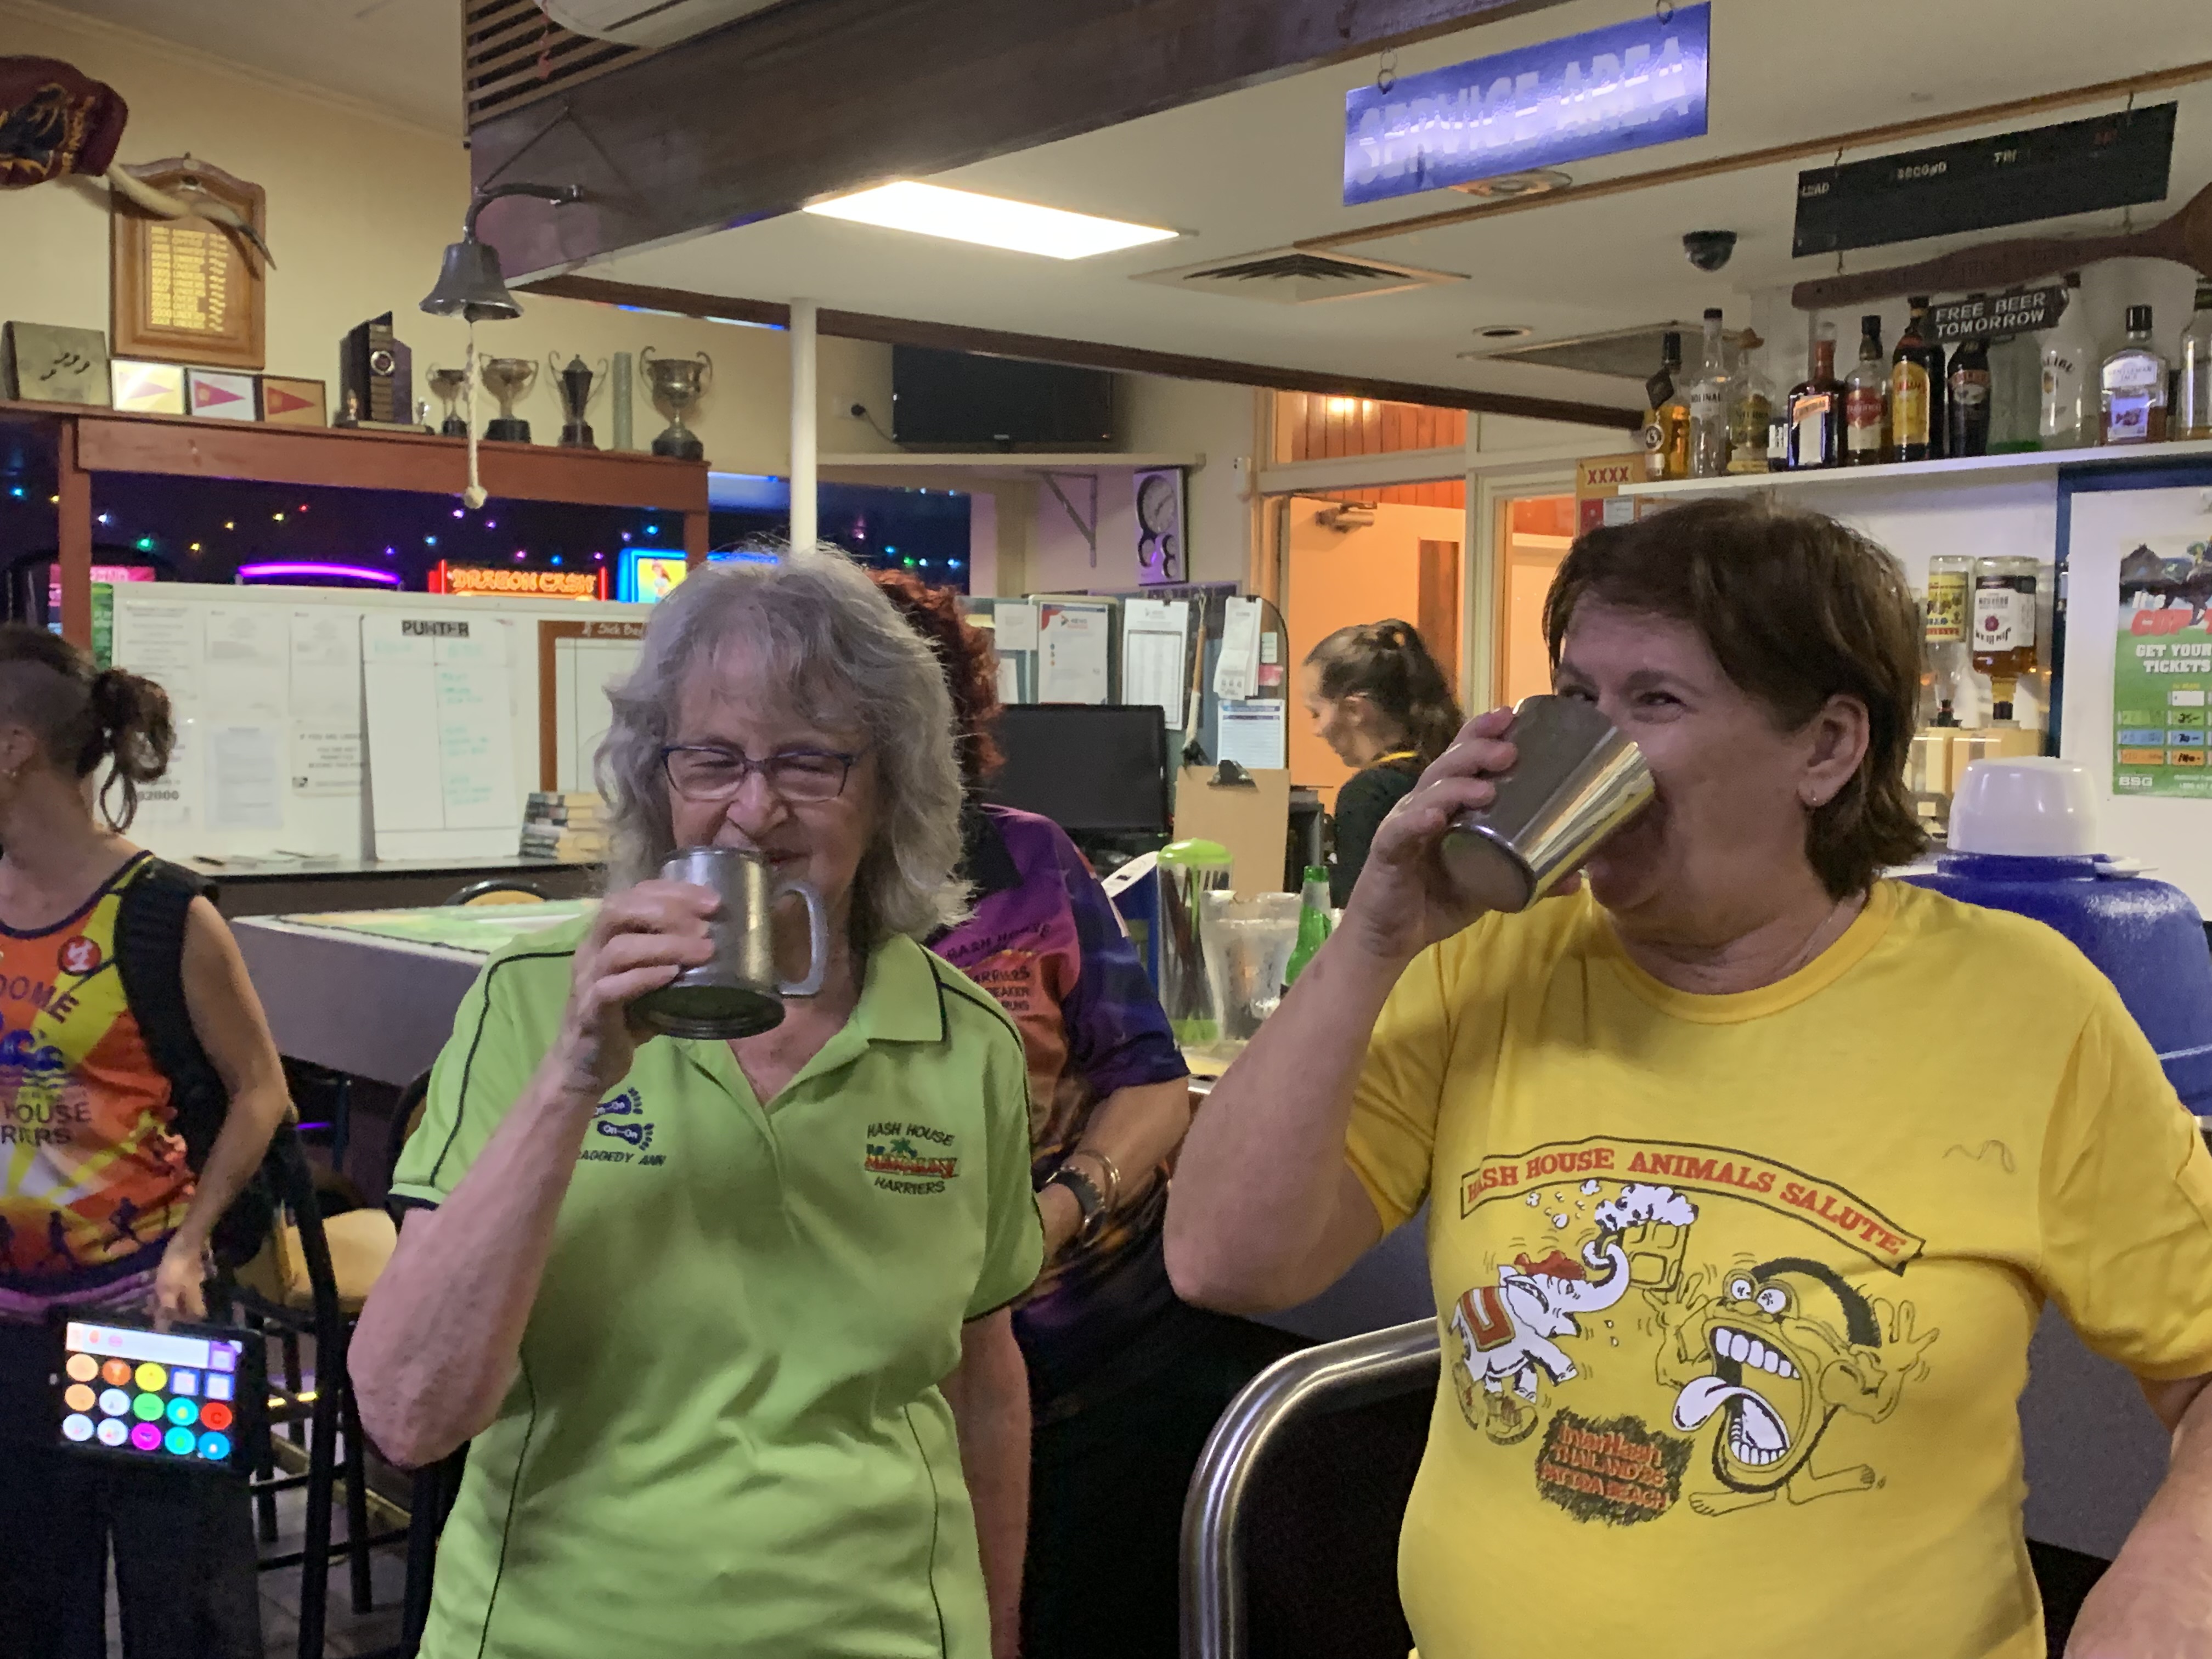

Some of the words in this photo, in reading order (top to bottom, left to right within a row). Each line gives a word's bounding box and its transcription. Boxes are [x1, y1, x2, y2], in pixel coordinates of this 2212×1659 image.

[1935, 302, 1984, 323] FREE
[1995, 291, 2046, 314] BEER
[1936, 308, 2045, 339] TOMORROW
[1587, 466, 1629, 485] XXXX
[452, 569, 538, 591] DRAGON
[538, 573, 597, 594] CASH
[2136, 644, 2166, 657] GET
[2171, 643, 2212, 657] YOUR
[2143, 659, 2211, 673] TICKETS
[867, 1121, 902, 1139] HASH
[906, 1123, 956, 1147] HOUSE
[873, 1176, 946, 1195] HARRIERS
[1468, 1166, 1519, 1203] HASH
[1525, 1147, 1615, 1180] HOUSE
[1627, 1150, 1777, 1193] ANIMALS
[1779, 1181, 1908, 1256] SALUTE
